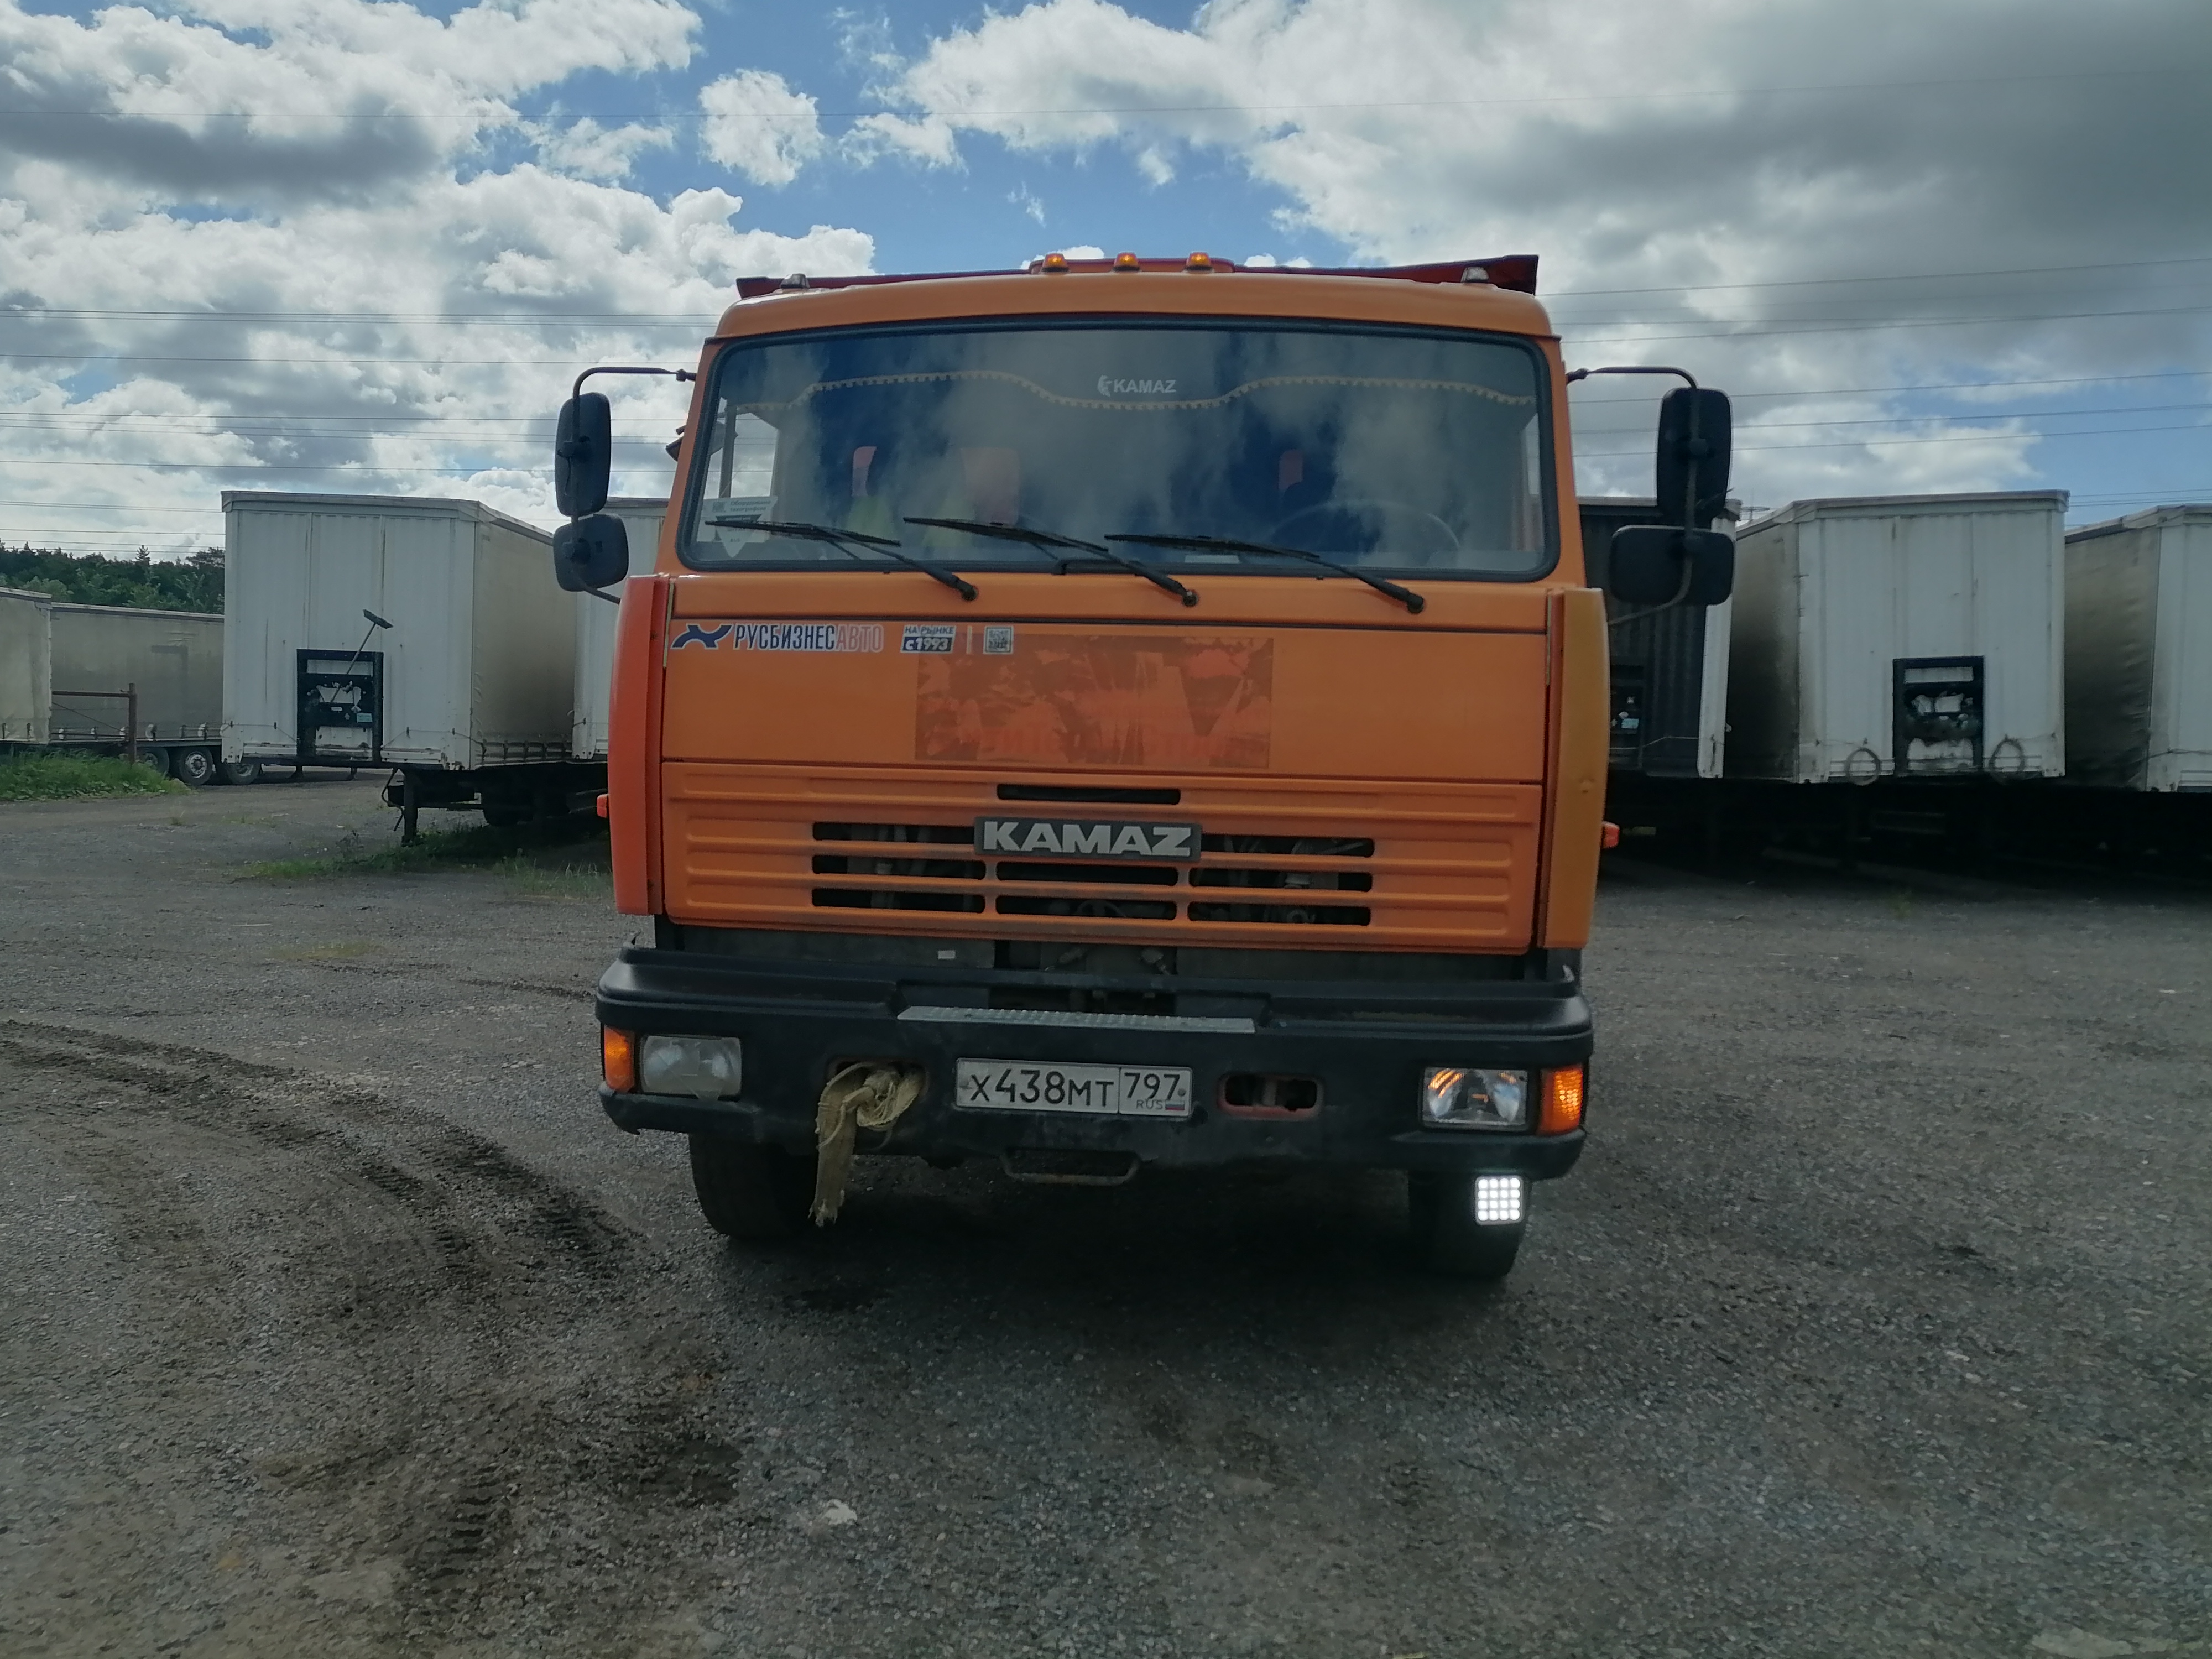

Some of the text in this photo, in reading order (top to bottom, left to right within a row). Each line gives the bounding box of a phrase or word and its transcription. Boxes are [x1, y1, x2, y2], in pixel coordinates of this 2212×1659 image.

[1113, 379, 1177, 393] KAMAZ
[983, 821, 1192, 857] KAMAZ
[970, 1068, 1181, 1107] Х438МТ 797
[1135, 1099, 1164, 1110] RUS
